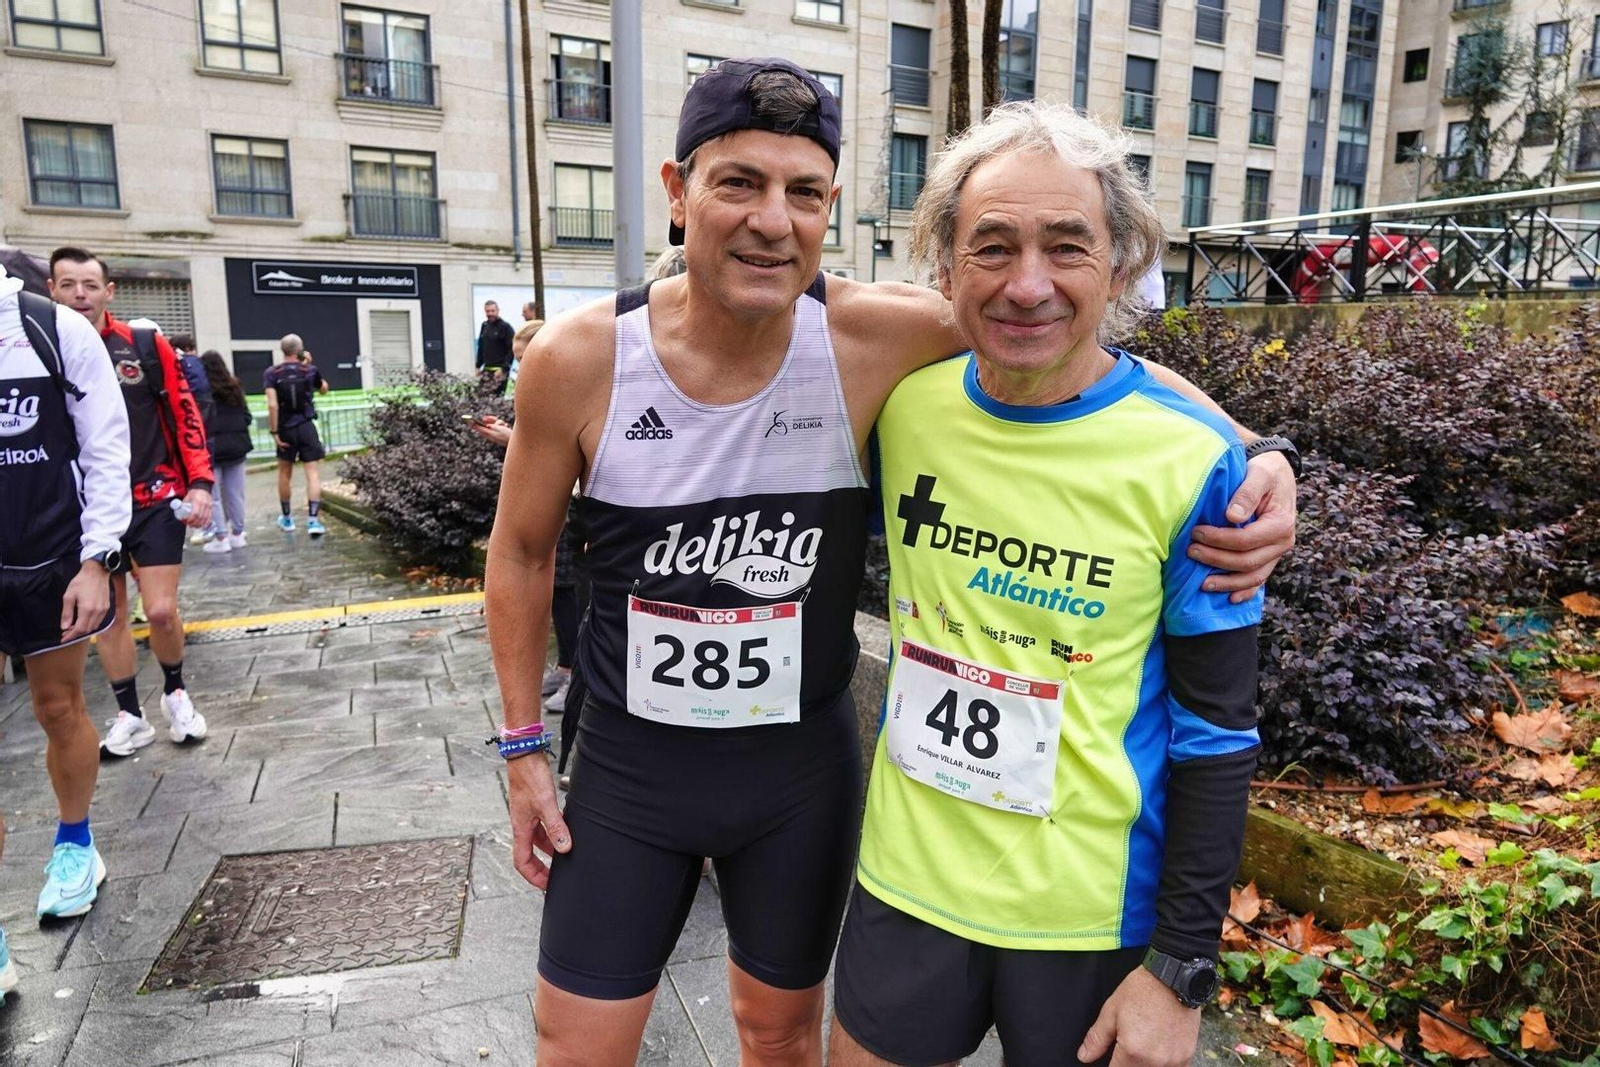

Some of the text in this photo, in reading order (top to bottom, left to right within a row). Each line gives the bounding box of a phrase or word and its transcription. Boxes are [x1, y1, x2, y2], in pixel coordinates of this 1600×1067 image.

[320, 275, 353, 285] Broker
[625, 427, 673, 440] adidas
[792, 421, 823, 430] DELIKIA
[643, 510, 824, 576] delikia
[929, 521, 1115, 589] DEPORTE
[742, 564, 790, 583] fresh
[966, 566, 1106, 619] Atlántico
[1008, 633, 1036, 649] auga
[1050, 638, 1074, 654] RUN
[651, 633, 771, 691] 285
[924, 688, 1001, 760] 48
[917, 744, 1001, 780] Enrique VILLAR ALVAREZ
